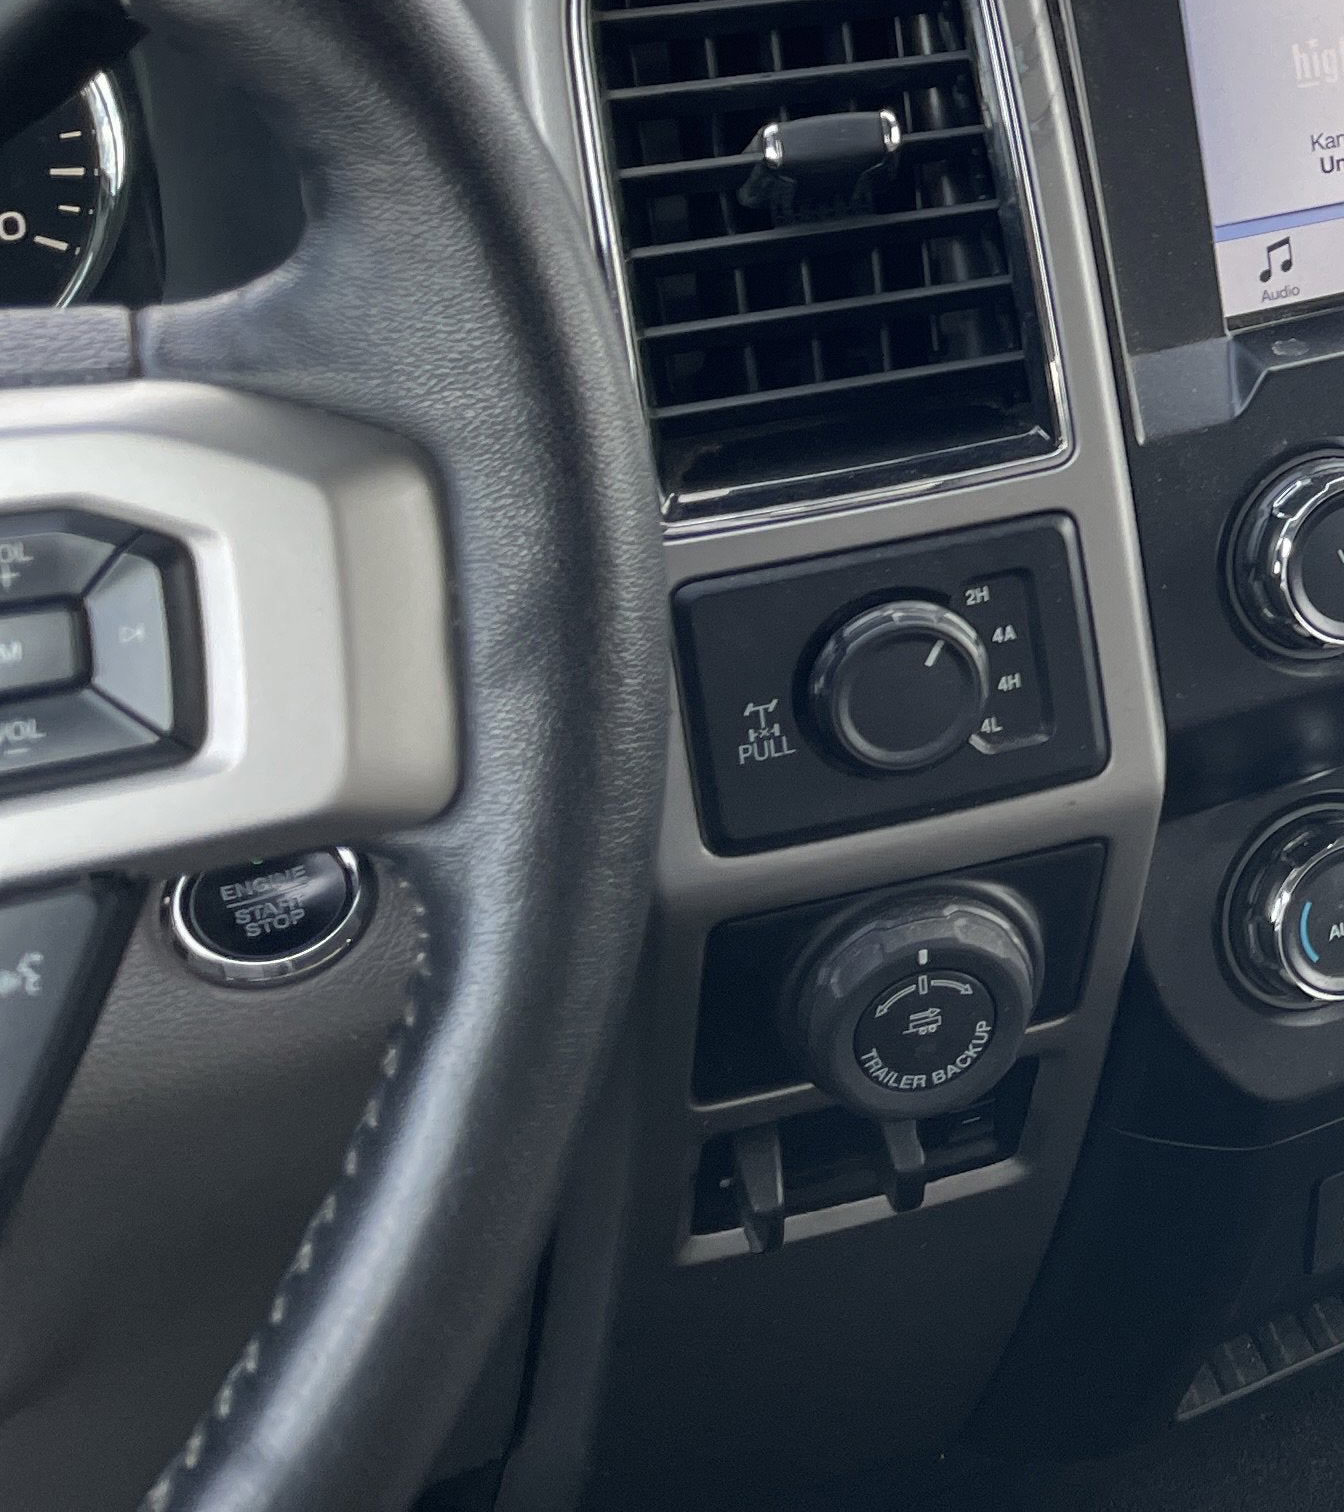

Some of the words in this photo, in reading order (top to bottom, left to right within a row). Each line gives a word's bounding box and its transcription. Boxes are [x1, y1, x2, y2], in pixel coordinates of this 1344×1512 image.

[1260, 285, 1301, 303] Audio
[965, 586, 990, 605] 2H
[992, 625, 1018, 644] 4A
[997, 673, 1022, 692] 4H
[980, 718, 1003, 735] 4L
[739, 735, 796, 764] PULL
[220, 865, 307, 901] ENGINE
[245, 908, 306, 937] STOP
[860, 1047, 927, 1089] TRAILER
[931, 1020, 993, 1086] BACKUP
